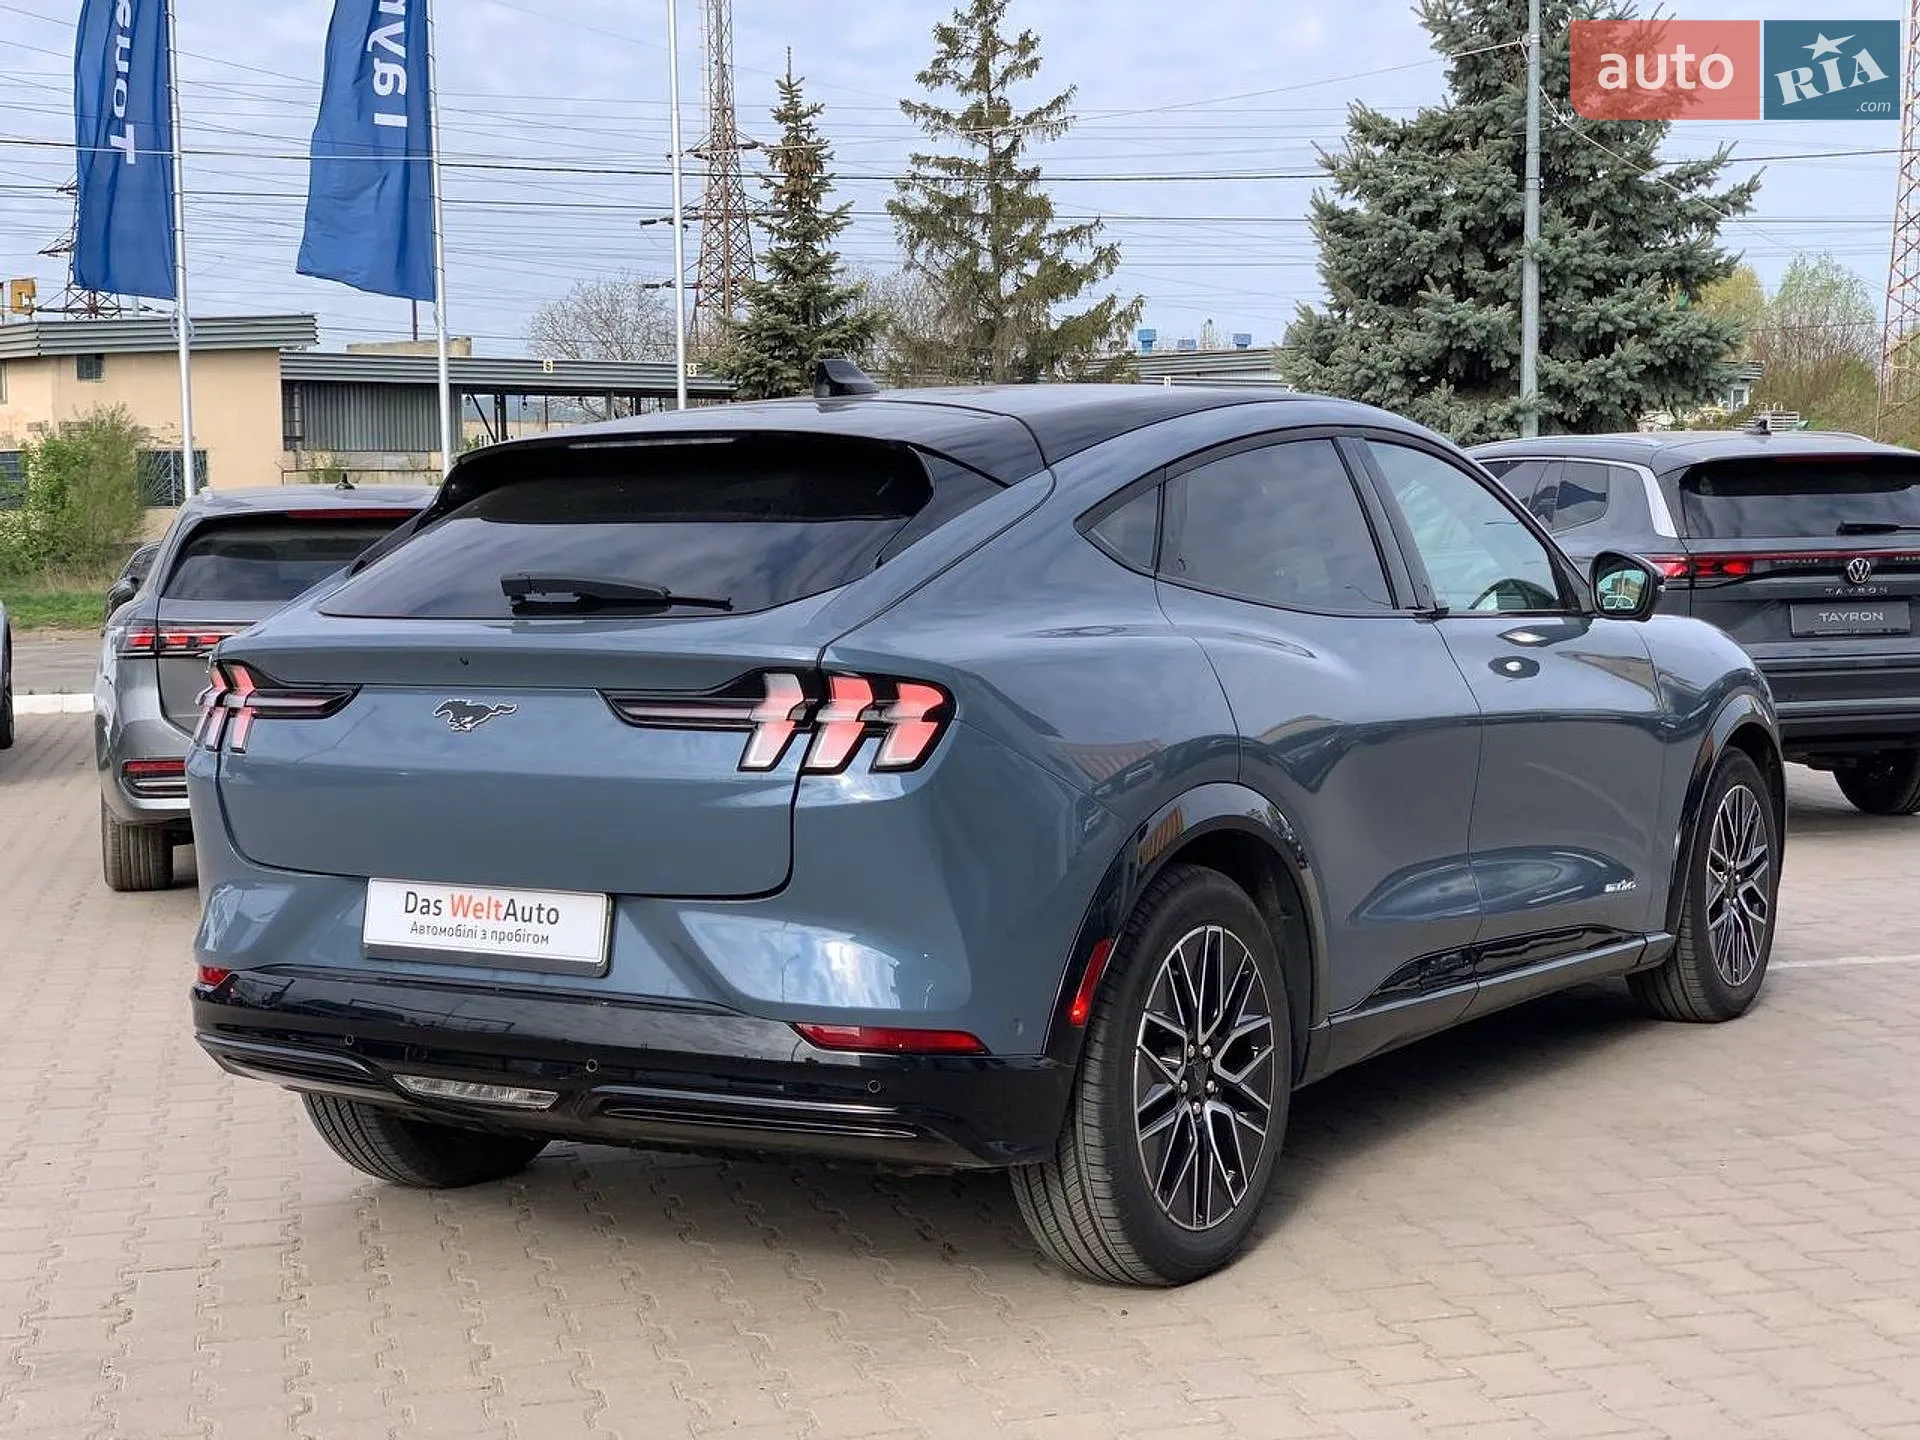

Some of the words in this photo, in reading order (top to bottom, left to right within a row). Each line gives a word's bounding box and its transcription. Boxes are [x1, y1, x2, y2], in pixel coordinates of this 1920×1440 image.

[1825, 586, 1888, 596] TAYRON
[1818, 612, 1884, 622] TAYRON
[404, 890, 443, 916] Das
[450, 893, 560, 925] WeltAuto
[410, 921, 477, 939] Автомобілі
[480, 929, 488, 940] з
[490, 928, 549, 944] пробігом
